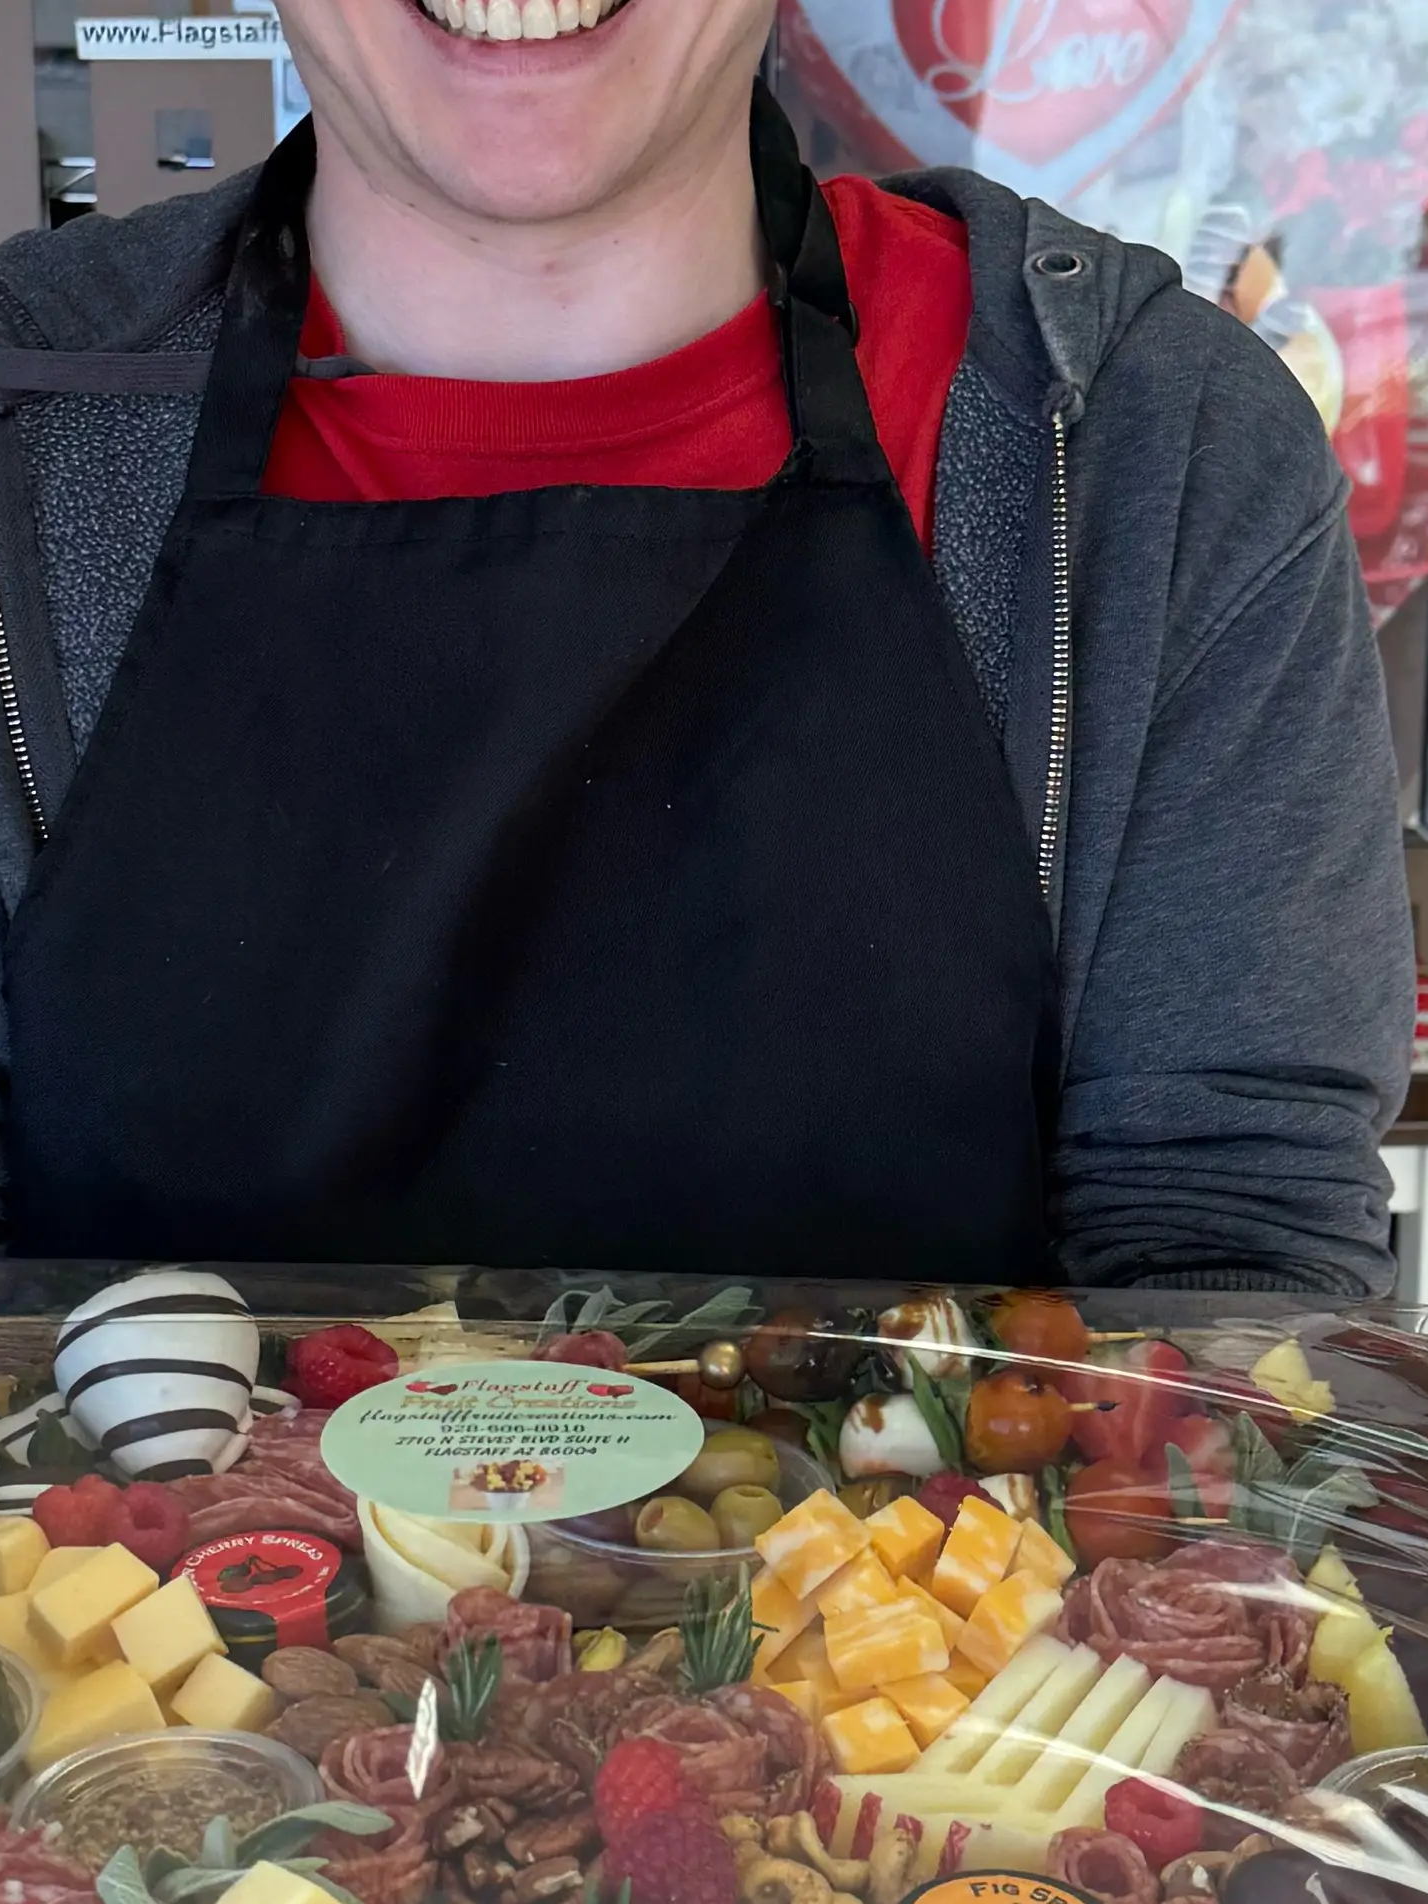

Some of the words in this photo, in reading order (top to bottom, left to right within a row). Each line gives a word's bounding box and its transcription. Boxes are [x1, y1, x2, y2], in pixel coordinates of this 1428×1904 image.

[462, 1379, 588, 1394] Flagstaff
[459, 1435, 516, 1445] STEVES
[564, 1435, 612, 1444] SUITE
[424, 1447, 510, 1457] FLAGSTAFF
[513, 1447, 535, 1457] AZ
[186, 1536, 255, 1567] CHERRY
[261, 1534, 324, 1561] SPREAD
[970, 1882, 1021, 1898] FIG
